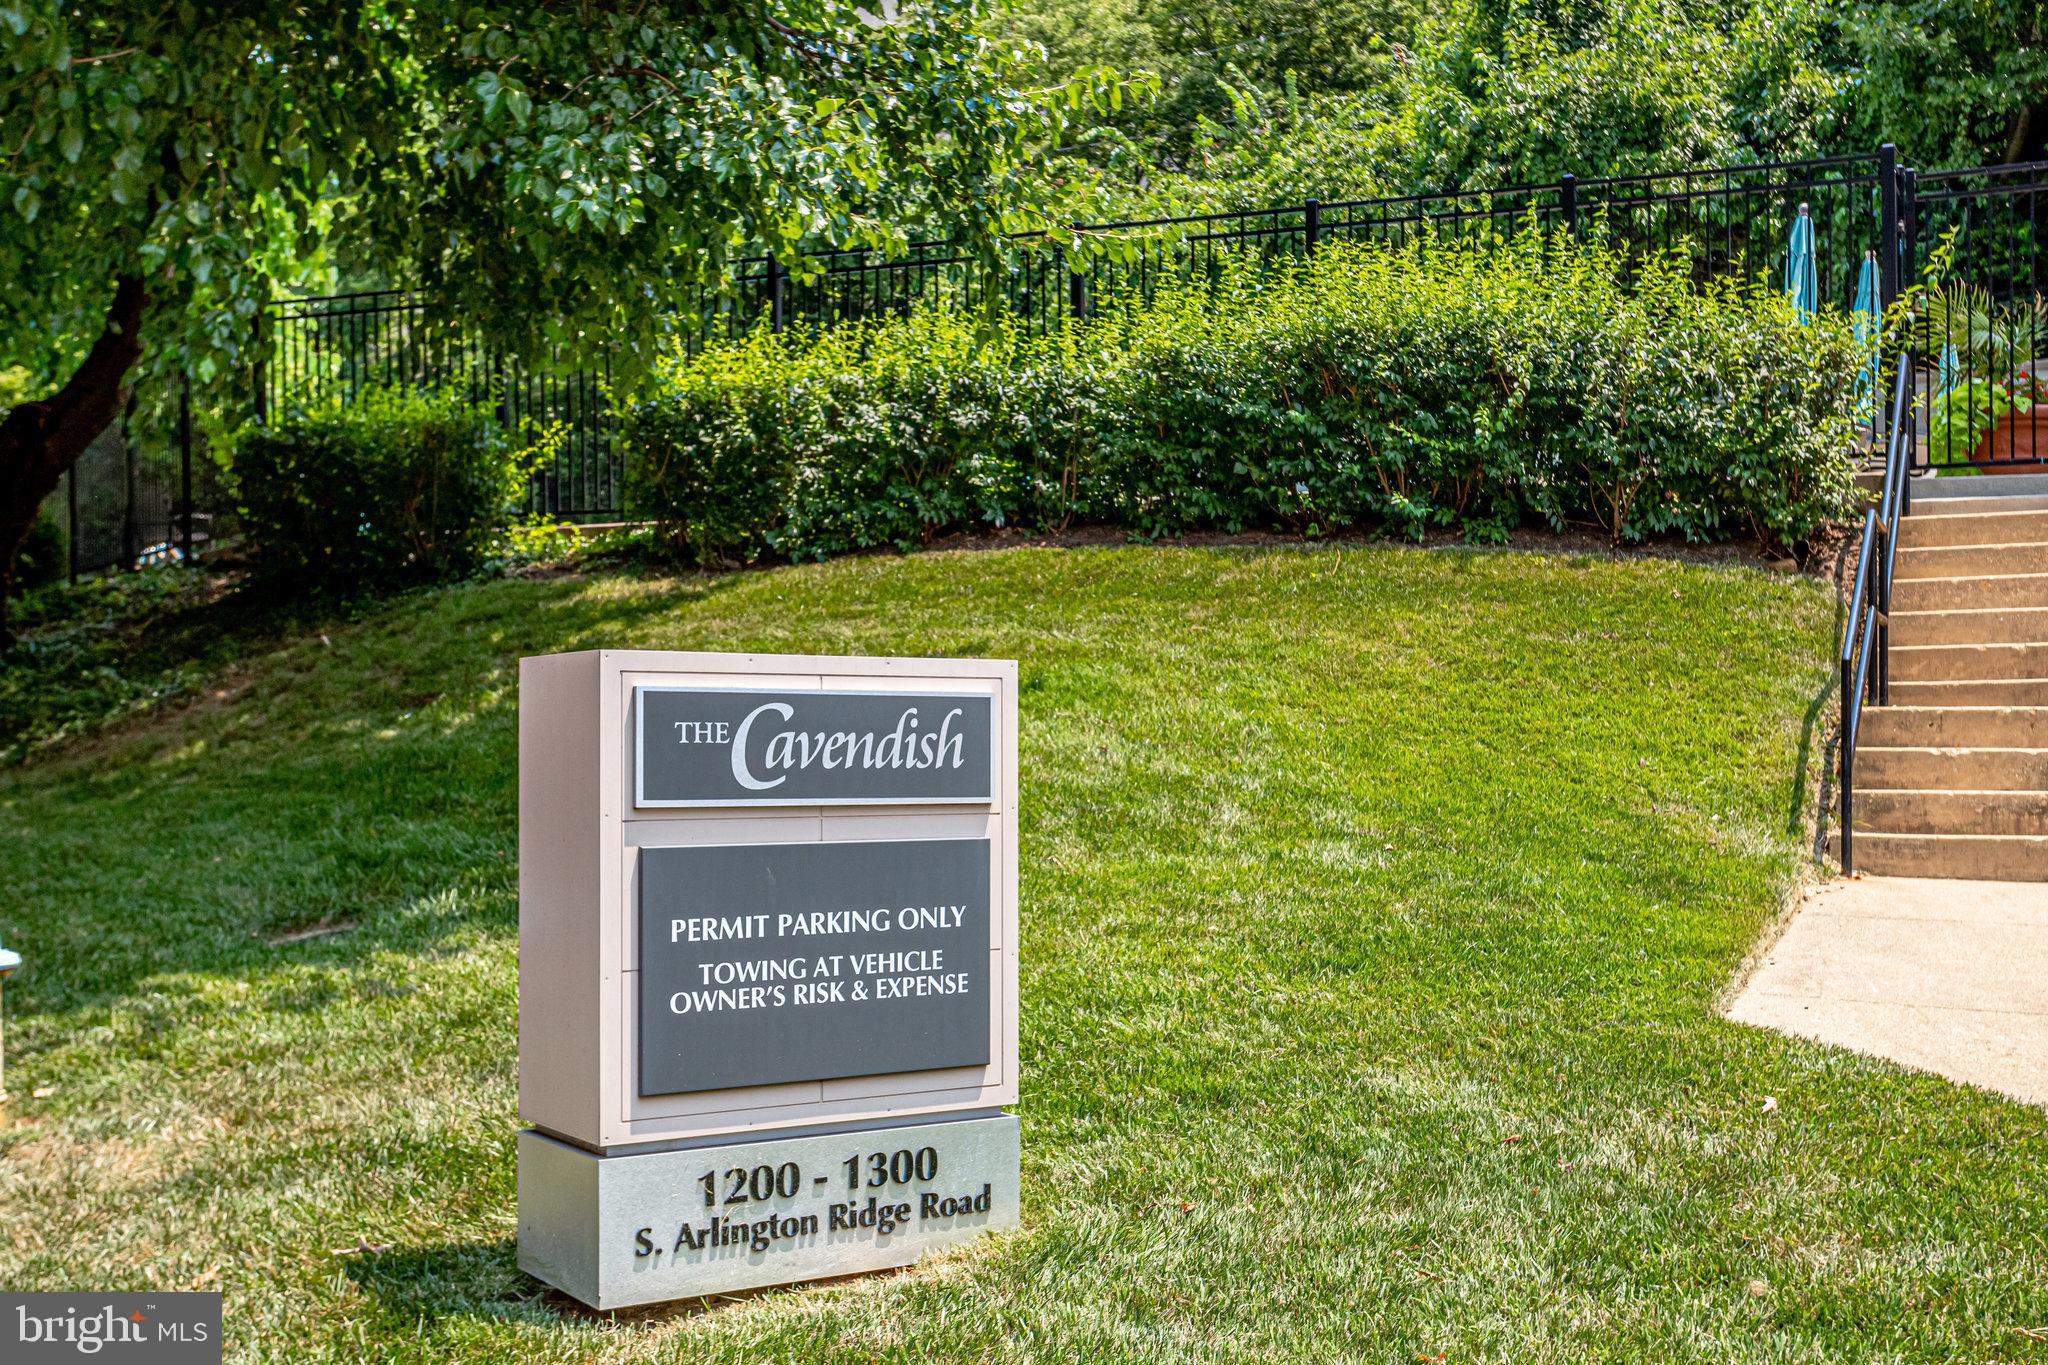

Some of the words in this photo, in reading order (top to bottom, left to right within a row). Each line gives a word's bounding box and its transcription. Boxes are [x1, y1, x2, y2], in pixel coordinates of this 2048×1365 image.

[674, 721, 731, 744] THE
[730, 702, 965, 791] Cavendish
[670, 914, 770, 943] PERMIT
[778, 908, 891, 937] PARKING
[897, 905, 967, 931] ONLY
[669, 984, 786, 1015] OWNER'S
[793, 980, 846, 1006] RISK
[850, 979, 869, 1002] &
[875, 972, 970, 1000] EXPENSE
[698, 957, 807, 986] TOWING
[812, 955, 844, 978] AT
[849, 949, 944, 975] VEHICLE
[697, 1161, 801, 1207] 1200
[814, 1176, 828, 1184] -
[842, 1146, 938, 1190] 1300
[634, 1227, 663, 1258] S.
[673, 1213, 819, 1253] Arlington
[829, 1197, 912, 1235] Ridge
[919, 1183, 992, 1220] Road
